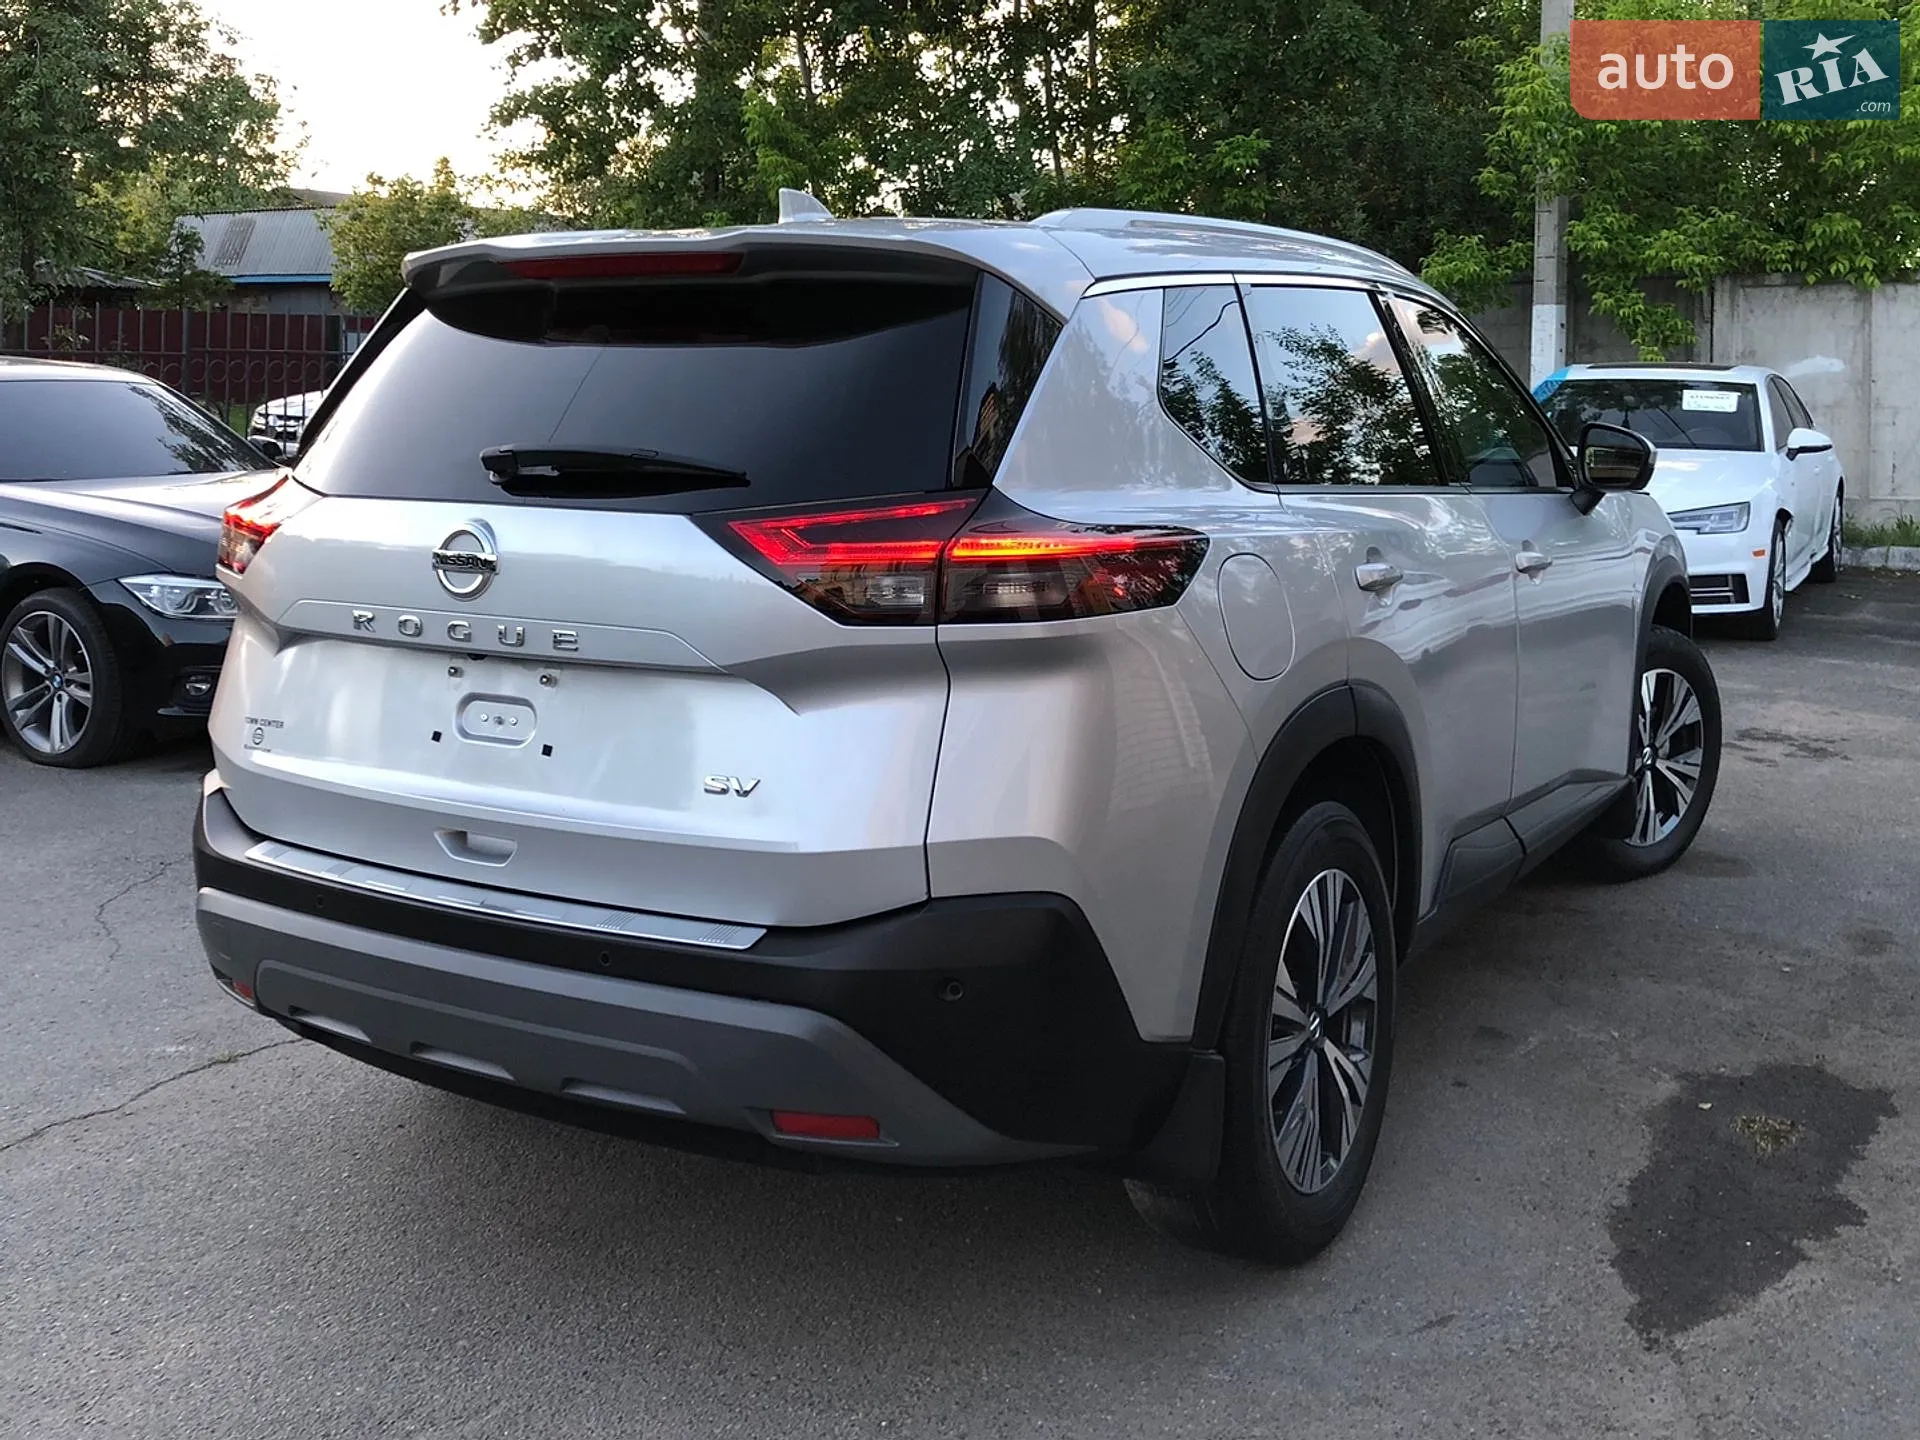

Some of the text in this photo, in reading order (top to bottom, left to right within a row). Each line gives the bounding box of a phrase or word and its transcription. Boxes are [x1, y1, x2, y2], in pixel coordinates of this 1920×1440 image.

[433, 552, 496, 571] NISSAN
[352, 609, 579, 652] ROGUE
[703, 775, 761, 798] SV
